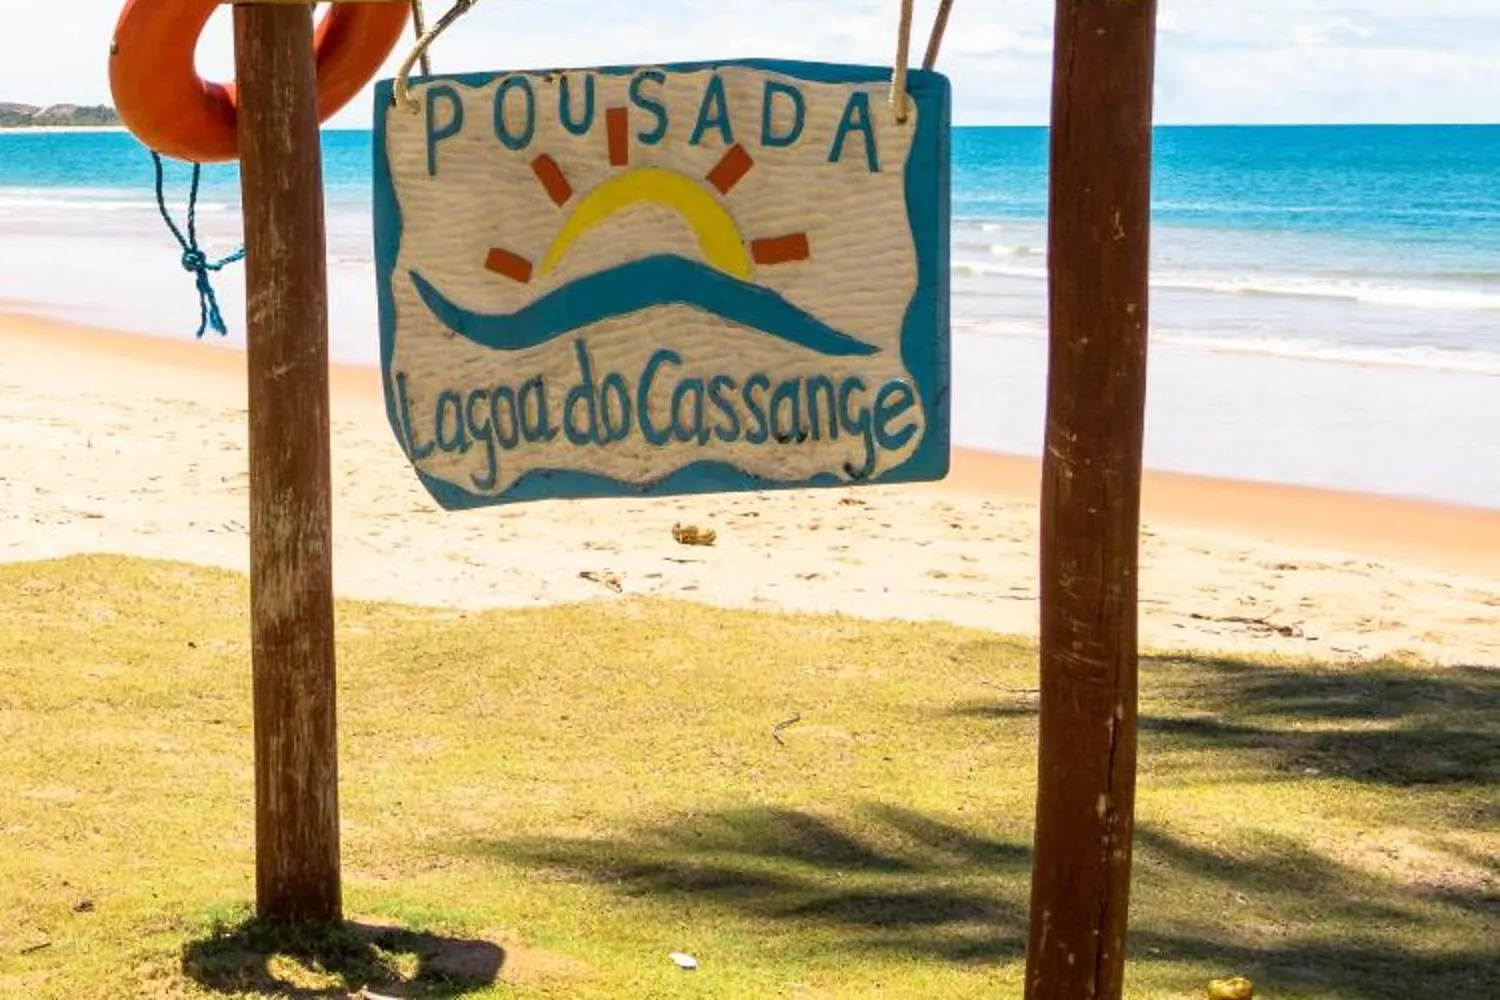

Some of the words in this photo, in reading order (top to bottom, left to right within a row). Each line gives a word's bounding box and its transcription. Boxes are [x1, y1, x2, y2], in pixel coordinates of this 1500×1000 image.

[426, 71, 881, 175] POUSADA
[397, 372, 558, 489] Lagoa
[565, 339, 632, 446] do
[638, 349, 918, 480] Cassange
